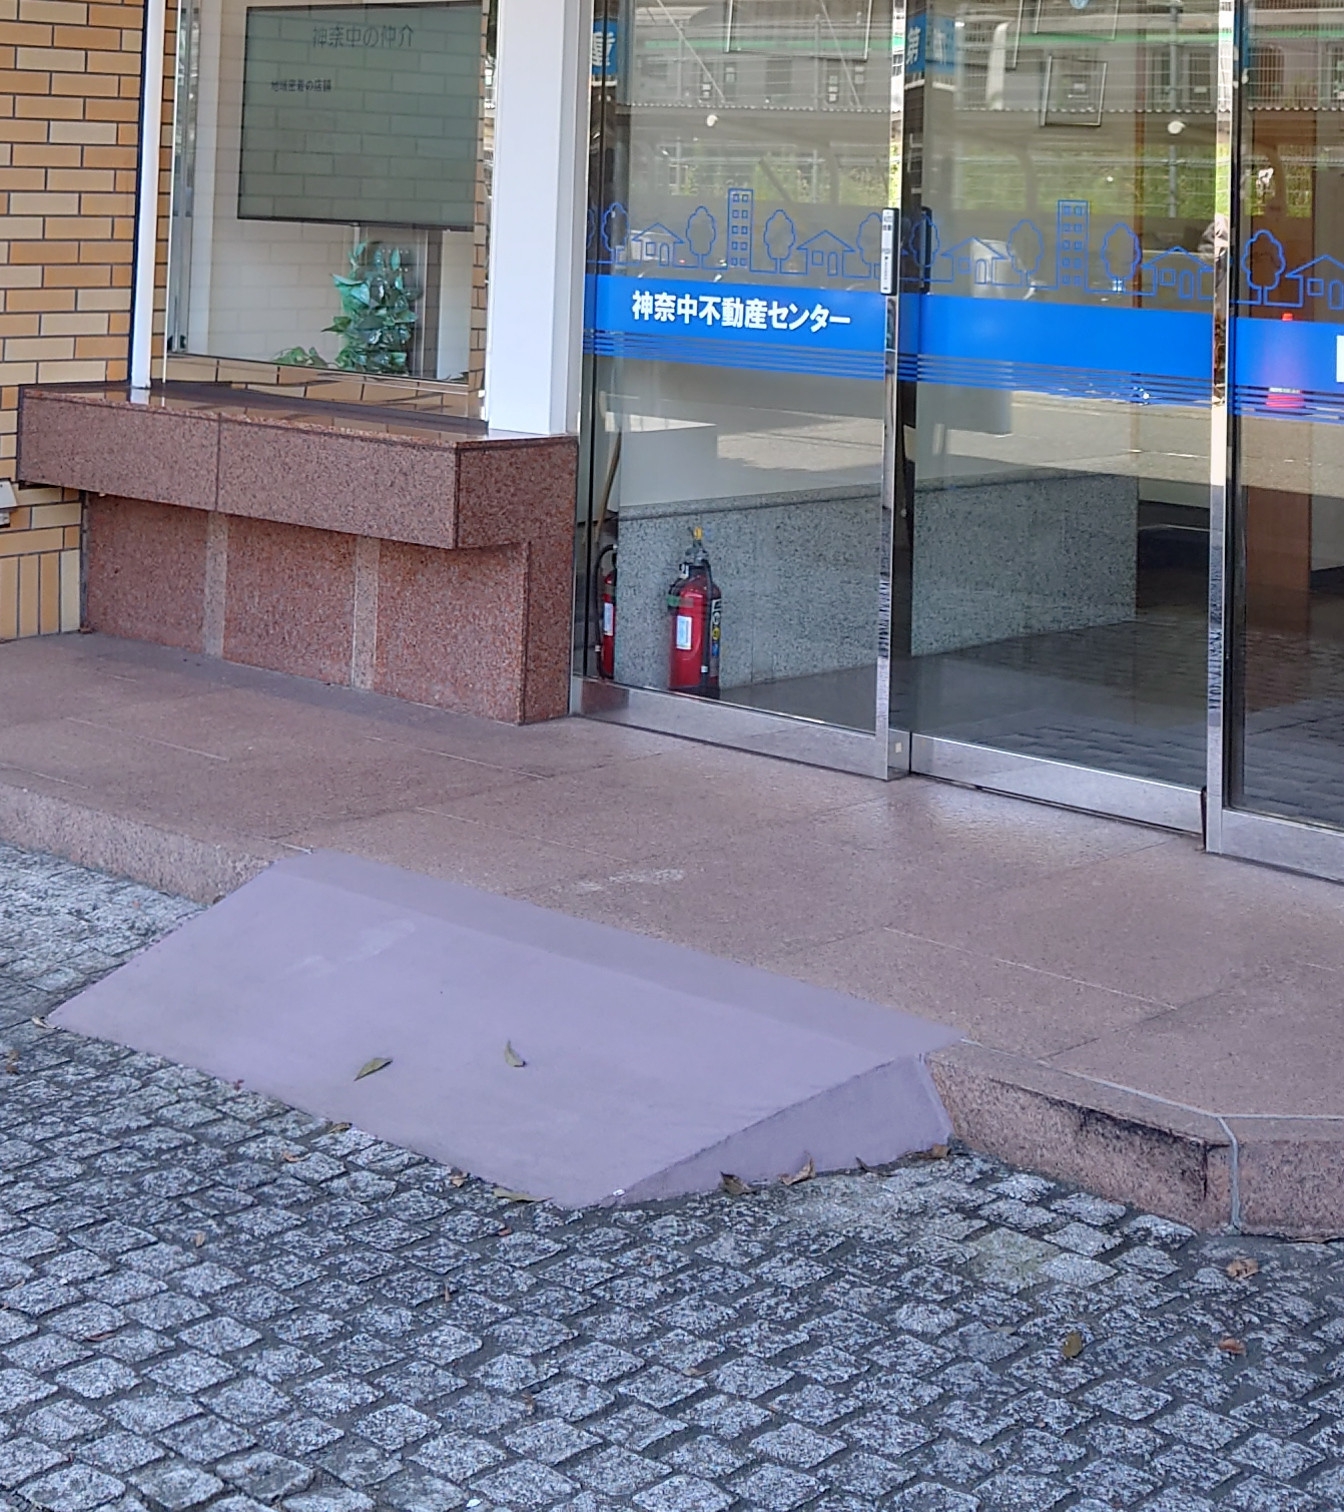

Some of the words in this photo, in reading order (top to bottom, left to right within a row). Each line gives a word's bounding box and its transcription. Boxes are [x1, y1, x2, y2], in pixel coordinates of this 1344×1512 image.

[312, 23, 415, 48] 神奈中の仲介
[632, 290, 852, 333] 神奈中不動産センター
